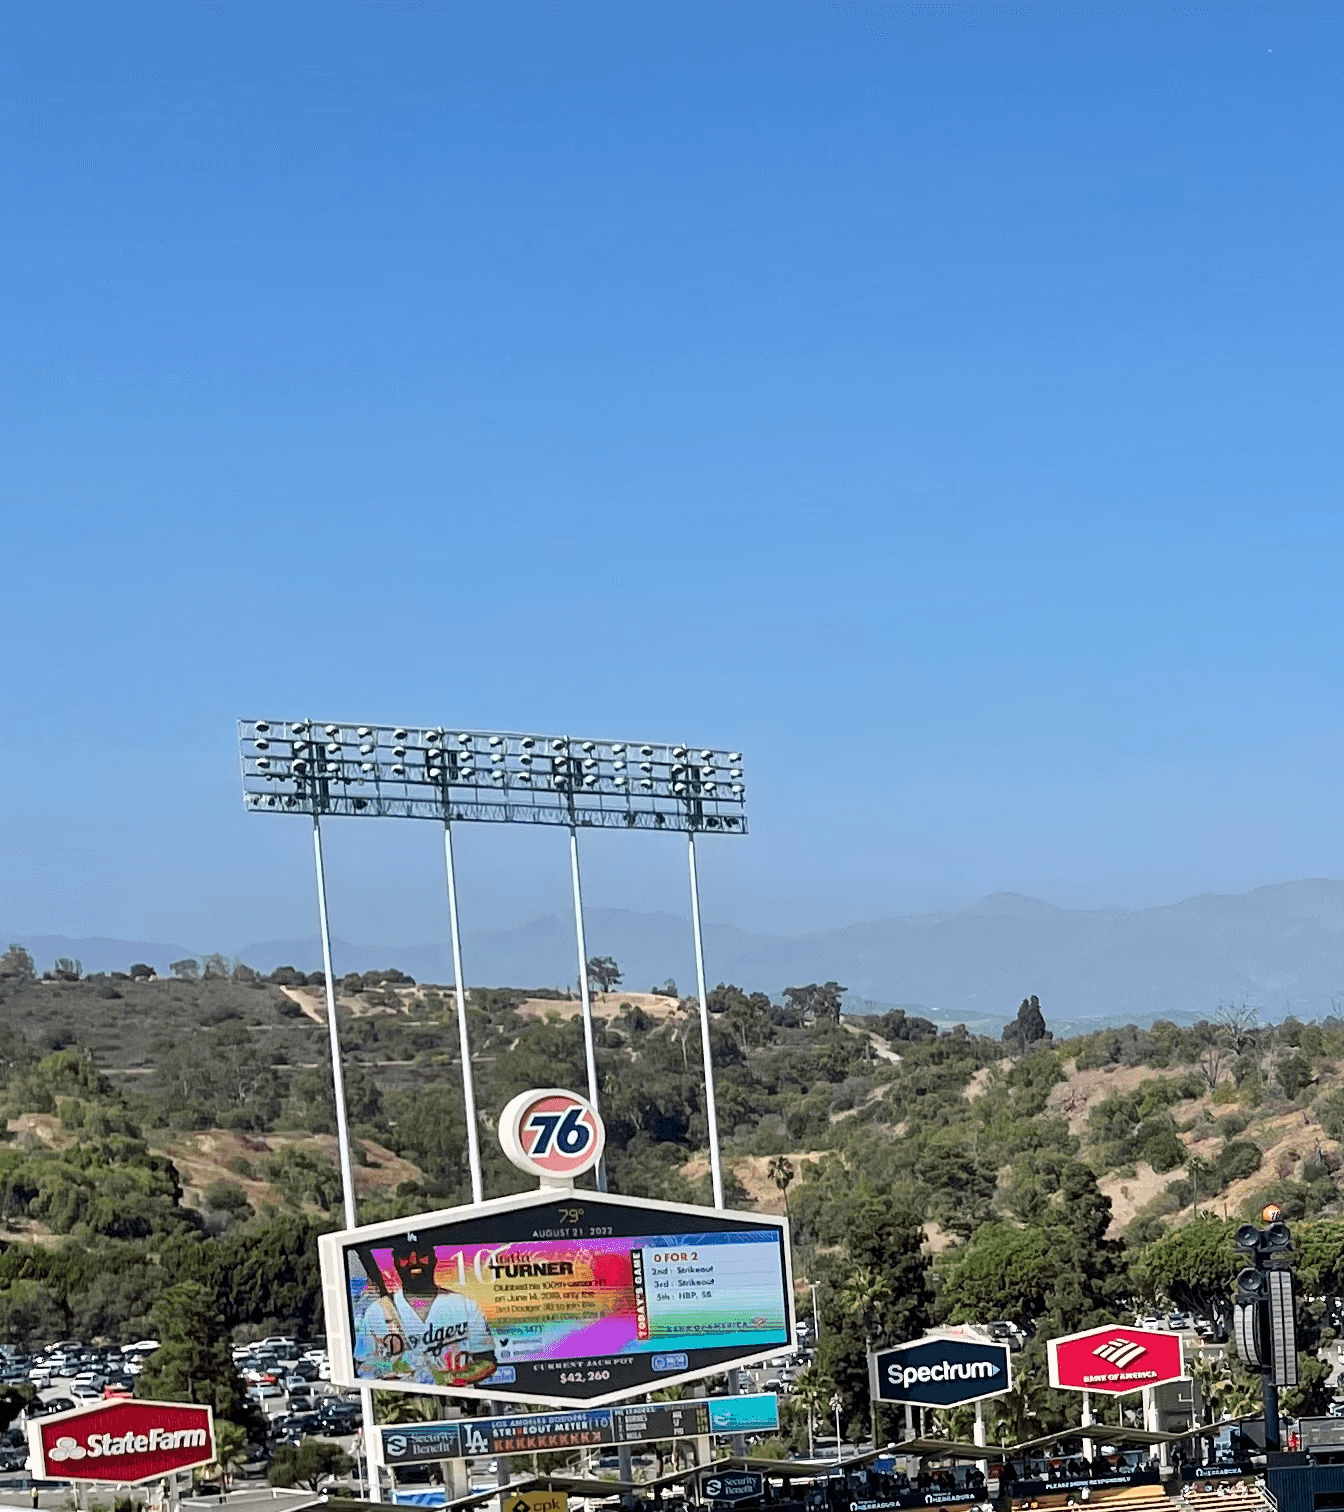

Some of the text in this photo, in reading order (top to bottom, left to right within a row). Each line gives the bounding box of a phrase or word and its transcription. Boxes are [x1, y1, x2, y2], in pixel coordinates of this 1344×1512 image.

[528, 1108, 591, 1157] 76
[532, 1228, 570, 1238] AUGUST
[654, 1252, 698, 1262] 0 FOR 2
[490, 1261, 573, 1279] TURNER
[534, 1362, 583, 1371] CURRENT
[560, 1370, 610, 1384] $42,260
[888, 1360, 994, 1388] Spectrum
[1083, 1371, 1158, 1383] BANK OF AMERICA
[493, 1422, 587, 1438] STRIEOUT METER
[465, 1423, 488, 1455] LA
[725, 1475, 758, 1489] Security
